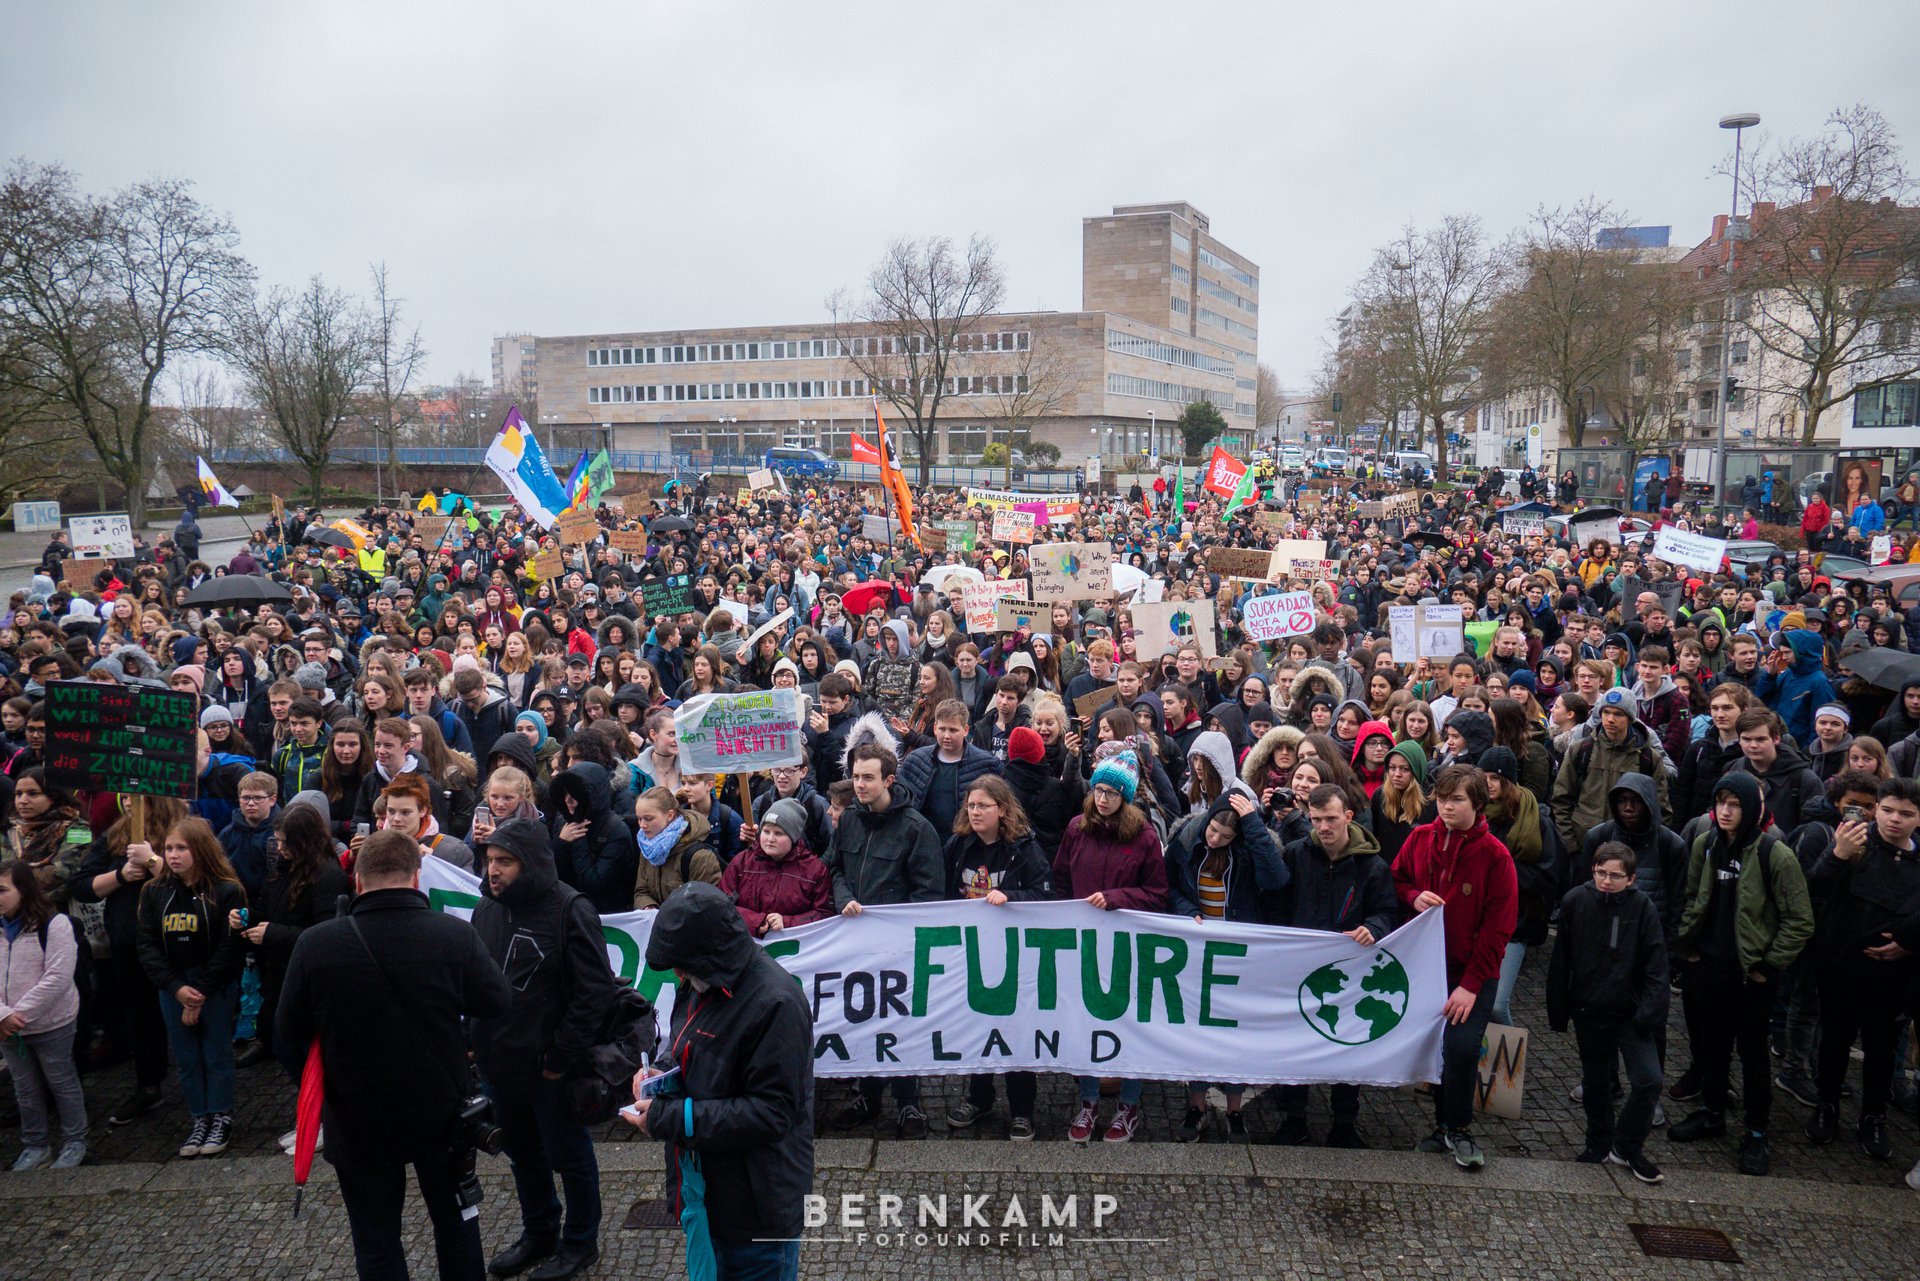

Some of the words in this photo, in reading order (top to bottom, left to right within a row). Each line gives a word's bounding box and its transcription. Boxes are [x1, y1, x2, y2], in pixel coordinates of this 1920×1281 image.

[972, 491, 1042, 504] KLIMASCHUTZ
[1046, 496, 1075, 504] JETZT
[1382, 493, 1407, 505] CYKA
[1396, 498, 1417, 508] BLYAT
[1385, 506, 1419, 519] MERKEL
[1516, 511, 1536, 519] CLIMATE
[995, 518, 1012, 526] HOT
[1504, 519, 1532, 528] CHANGING
[993, 533, 1012, 541] COALS
[74, 544, 101, 552] MENSCH
[1666, 535, 1717, 552] ENERGIEWENDE
[1673, 543, 1705, 555] BRAUCHT
[1032, 557, 1047, 568] The
[1091, 552, 1107, 562] Why
[1033, 569, 1052, 577] climate
[1089, 566, 1110, 575] aren't
[1035, 584, 1065, 594] changing
[1087, 577, 1108, 591] we?
[1656, 583, 1664, 591] TO
[669, 587, 689, 597] kann
[660, 595, 683, 606] nicht
[1000, 599, 1027, 607] THERE
[646, 602, 695, 619] wiederbeleben
[1010, 609, 1039, 617] PLANET
[1248, 600, 1276, 619] SUCK
[1277, 598, 1285, 612] A
[1249, 617, 1270, 629] NOT
[1271, 616, 1280, 625] A
[1251, 625, 1289, 640] STRAW
[53, 687, 100, 703] WIR
[101, 695, 132, 707] sind
[707, 693, 773, 712] STUNDEN
[51, 709, 100, 723] WIR
[680, 729, 707, 744] den
[714, 720, 800, 740] KLIMAWANDEL
[54, 730, 91, 743] weil
[98, 729, 134, 746] IHR
[142, 734, 185, 754] UNS
[715, 733, 786, 756] NICHT!
[53, 753, 79, 769] die
[88, 752, 191, 782] ZUKUNFT
[812, 969, 910, 1024] FOR
[911, 925, 1248, 1028] FUTURE
[813, 1028, 1122, 1063] ARLAND
